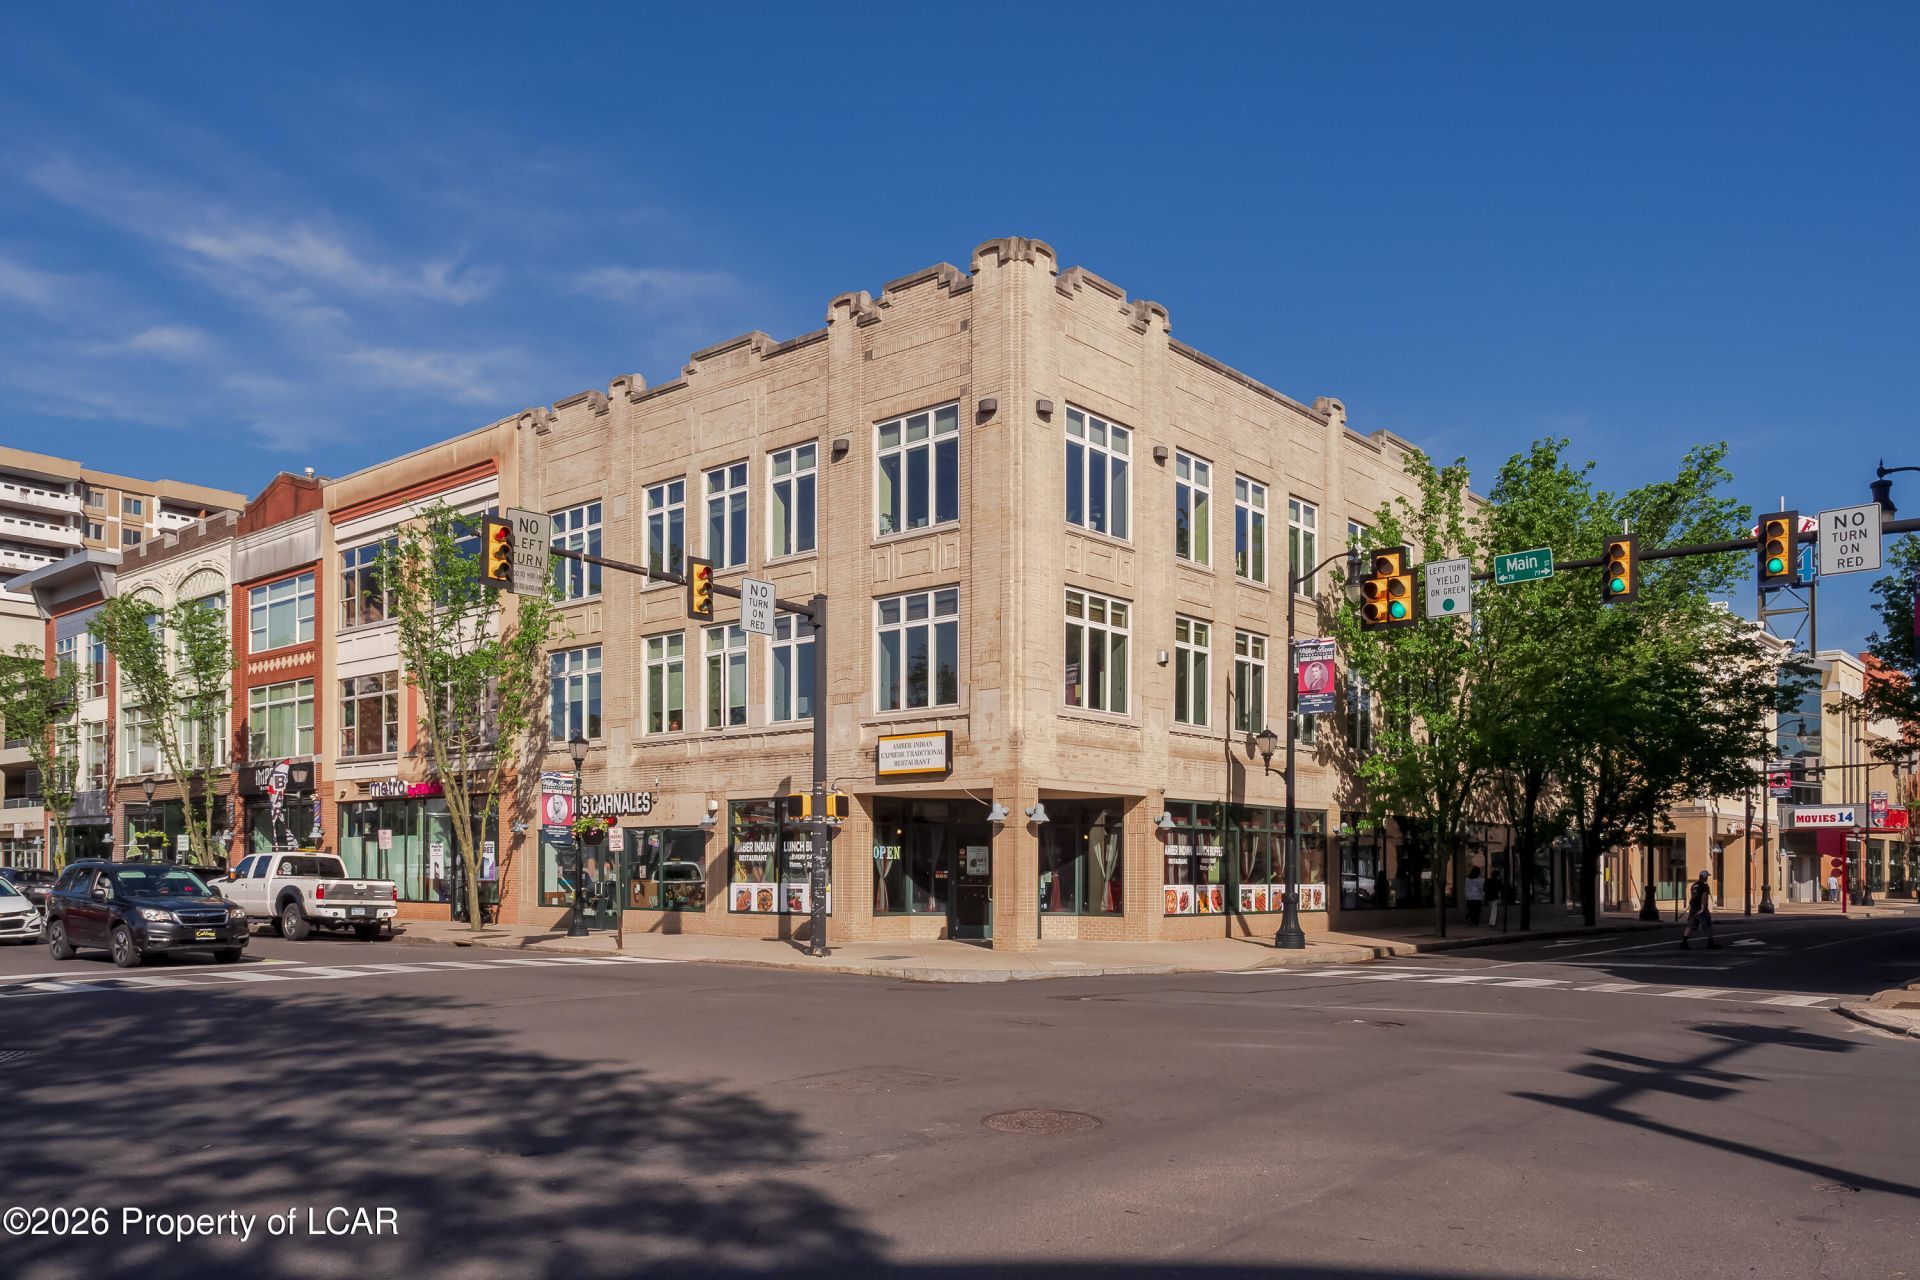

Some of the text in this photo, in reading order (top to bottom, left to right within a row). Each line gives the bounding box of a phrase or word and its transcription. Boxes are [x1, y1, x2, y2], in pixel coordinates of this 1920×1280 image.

[520, 518, 538, 534] NO
[1834, 512, 1865, 529] NO
[1832, 528, 1868, 542] TURN
[1840, 543, 1860, 554] ON
[514, 551, 542, 566] URN
[1506, 556, 1538, 572] Main
[1837, 556, 1864, 568] RED
[1430, 564, 1466, 576] LEFT TURN
[1436, 574, 1460, 586] YIELD
[750, 584, 768, 598] NO
[1431, 586, 1465, 597] ON GREEN
[749, 598, 768, 608] TURN
[753, 610, 764, 619] ON
[750, 620, 765, 630] RED
[906, 749, 944, 757] TRADITIONAL
[370, 778, 406, 796] metro
[592, 792, 651, 814] CARNALES
[1838, 812, 1853, 822] 14
[754, 842, 775, 852] INDIAN
[784, 841, 804, 852] LUNCH
[873, 846, 901, 860] OPEN
